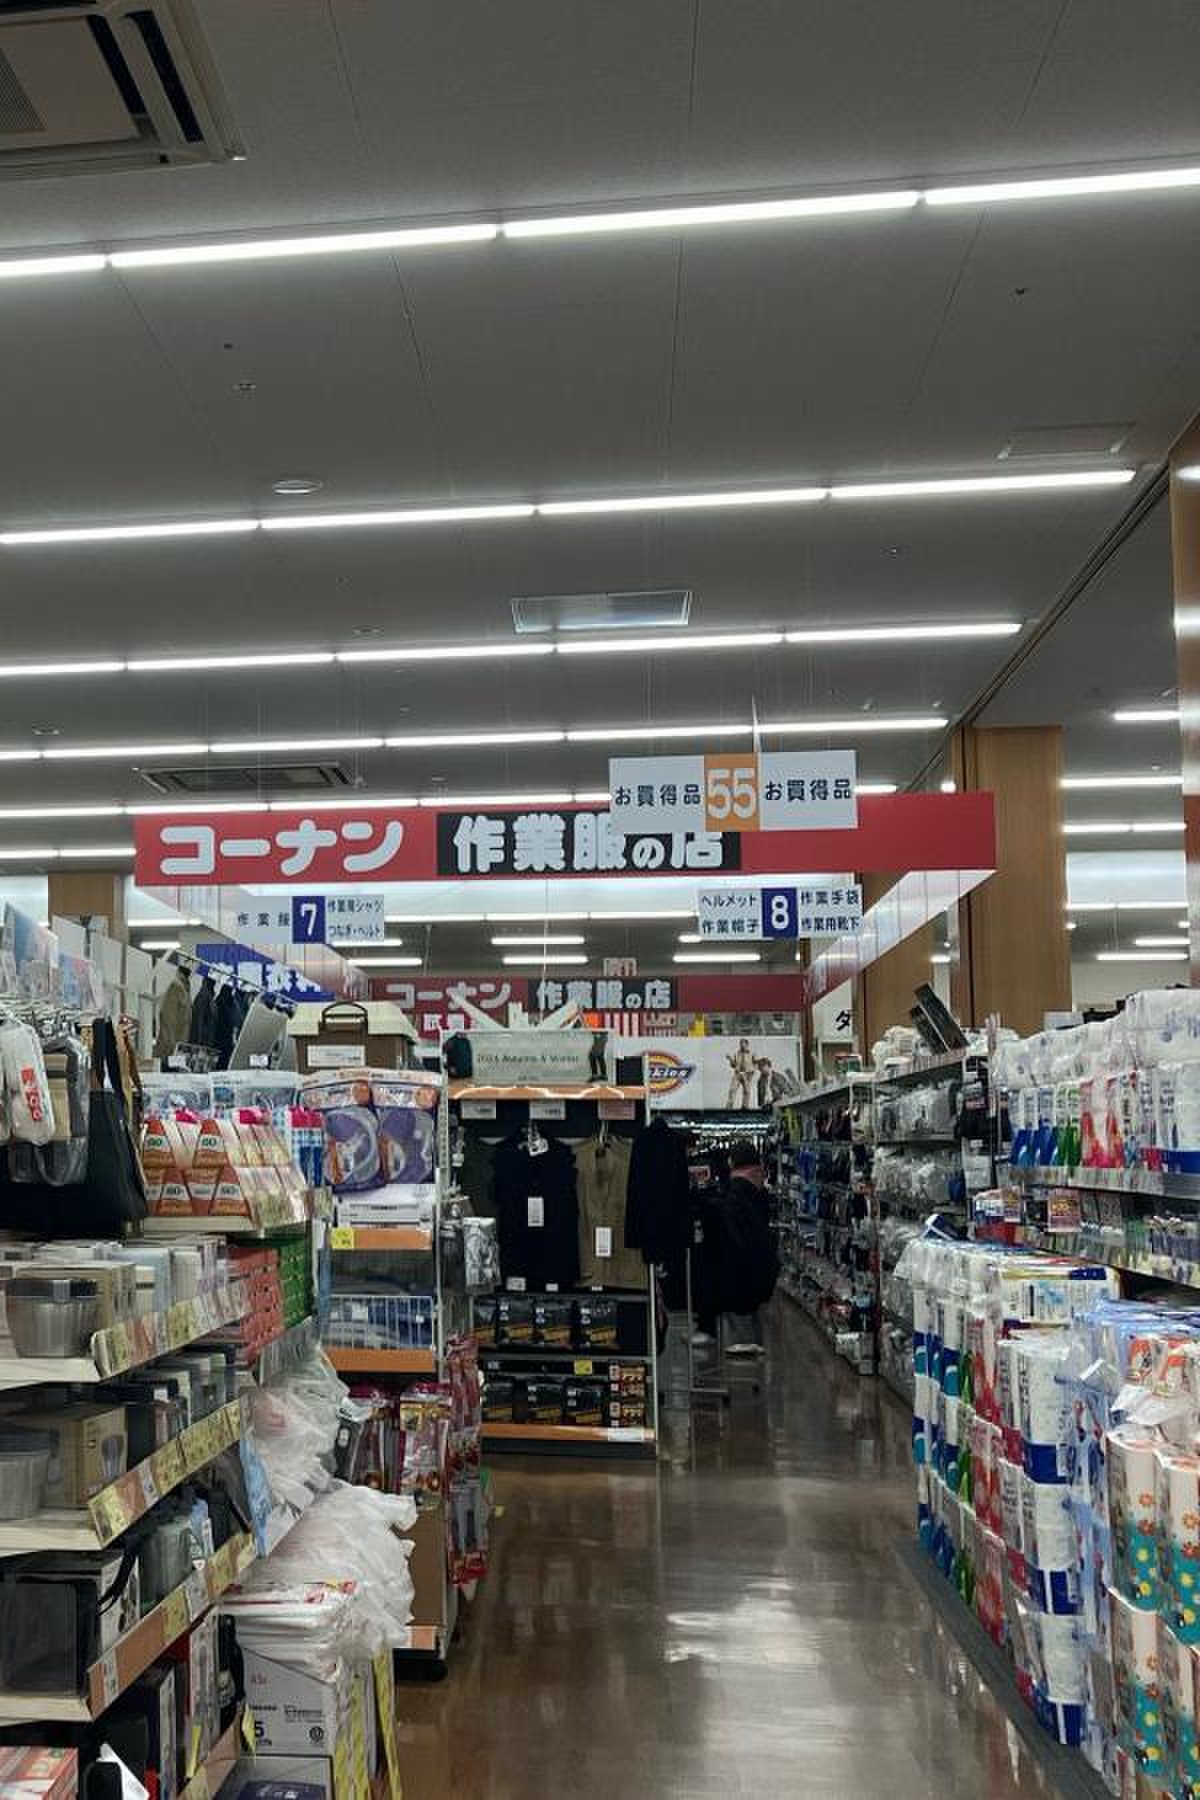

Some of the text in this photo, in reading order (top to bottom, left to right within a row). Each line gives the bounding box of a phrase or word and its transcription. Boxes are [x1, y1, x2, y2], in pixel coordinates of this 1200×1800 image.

[615, 783, 701, 807] お買得品
[706, 768, 755, 820] 55
[765, 778, 851, 800] お買得品
[160, 819, 403, 876] コーナン
[453, 813, 722, 871] 作業服の店
[702, 894, 756, 906] ヘルメット
[801, 889, 859, 905] 作業手袋
[301, 903, 317, 936] 7
[702, 918, 759, 934] 作業帽子
[771, 895, 789, 929] 8
[386, 981, 511, 1009] コーナン
